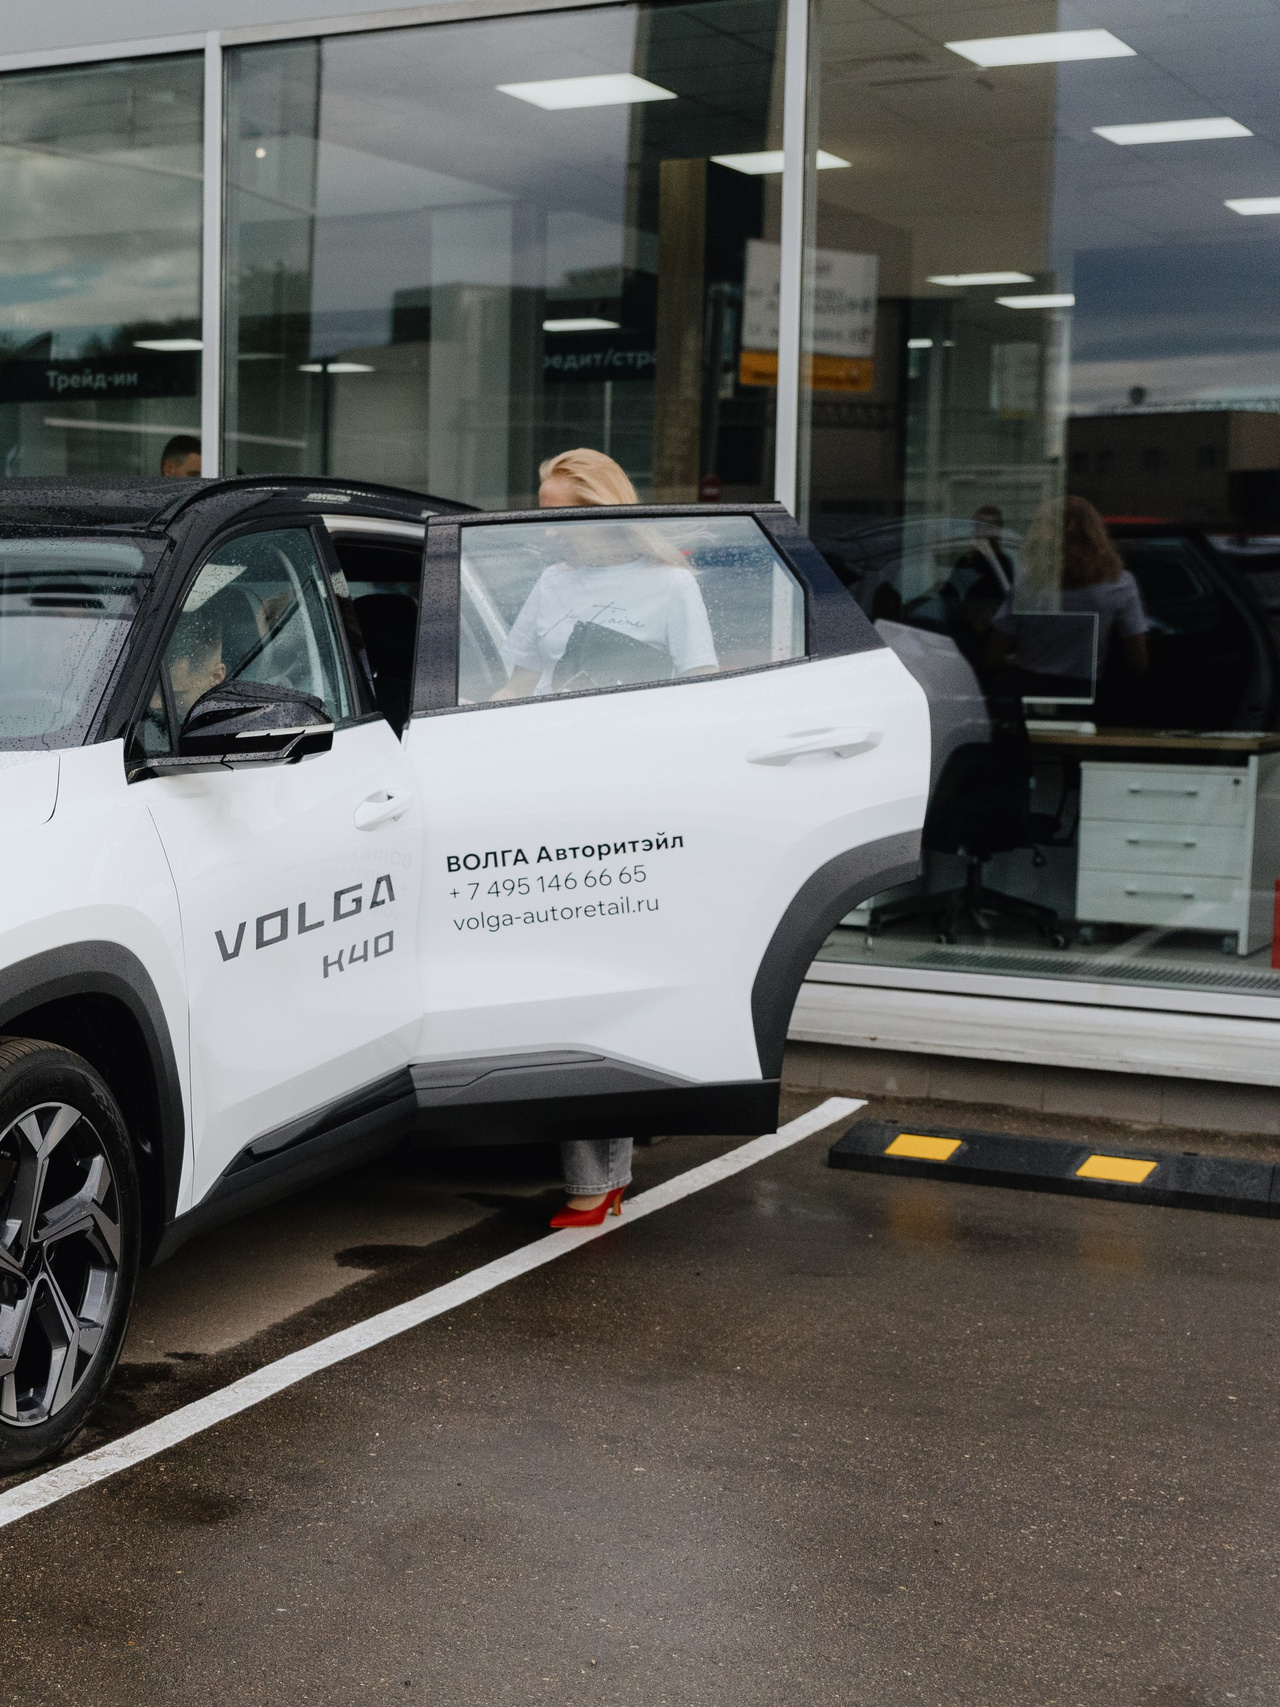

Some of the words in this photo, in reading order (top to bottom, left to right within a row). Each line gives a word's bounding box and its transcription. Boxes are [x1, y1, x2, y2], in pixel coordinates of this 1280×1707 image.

[46, 369, 138, 393] Трейд-ин
[446, 847, 529, 873] ВОЛГА
[536, 831, 685, 864] Авторитэйл
[467, 882, 481, 901] 7
[488, 876, 530, 898] 495
[537, 872, 578, 893] 146
[583, 868, 613, 889] 66
[618, 864, 647, 885] 65
[214, 873, 396, 962] VOLGA
[453, 895, 659, 933] volga-autoretail.ru
[322, 930, 394, 979] K40
